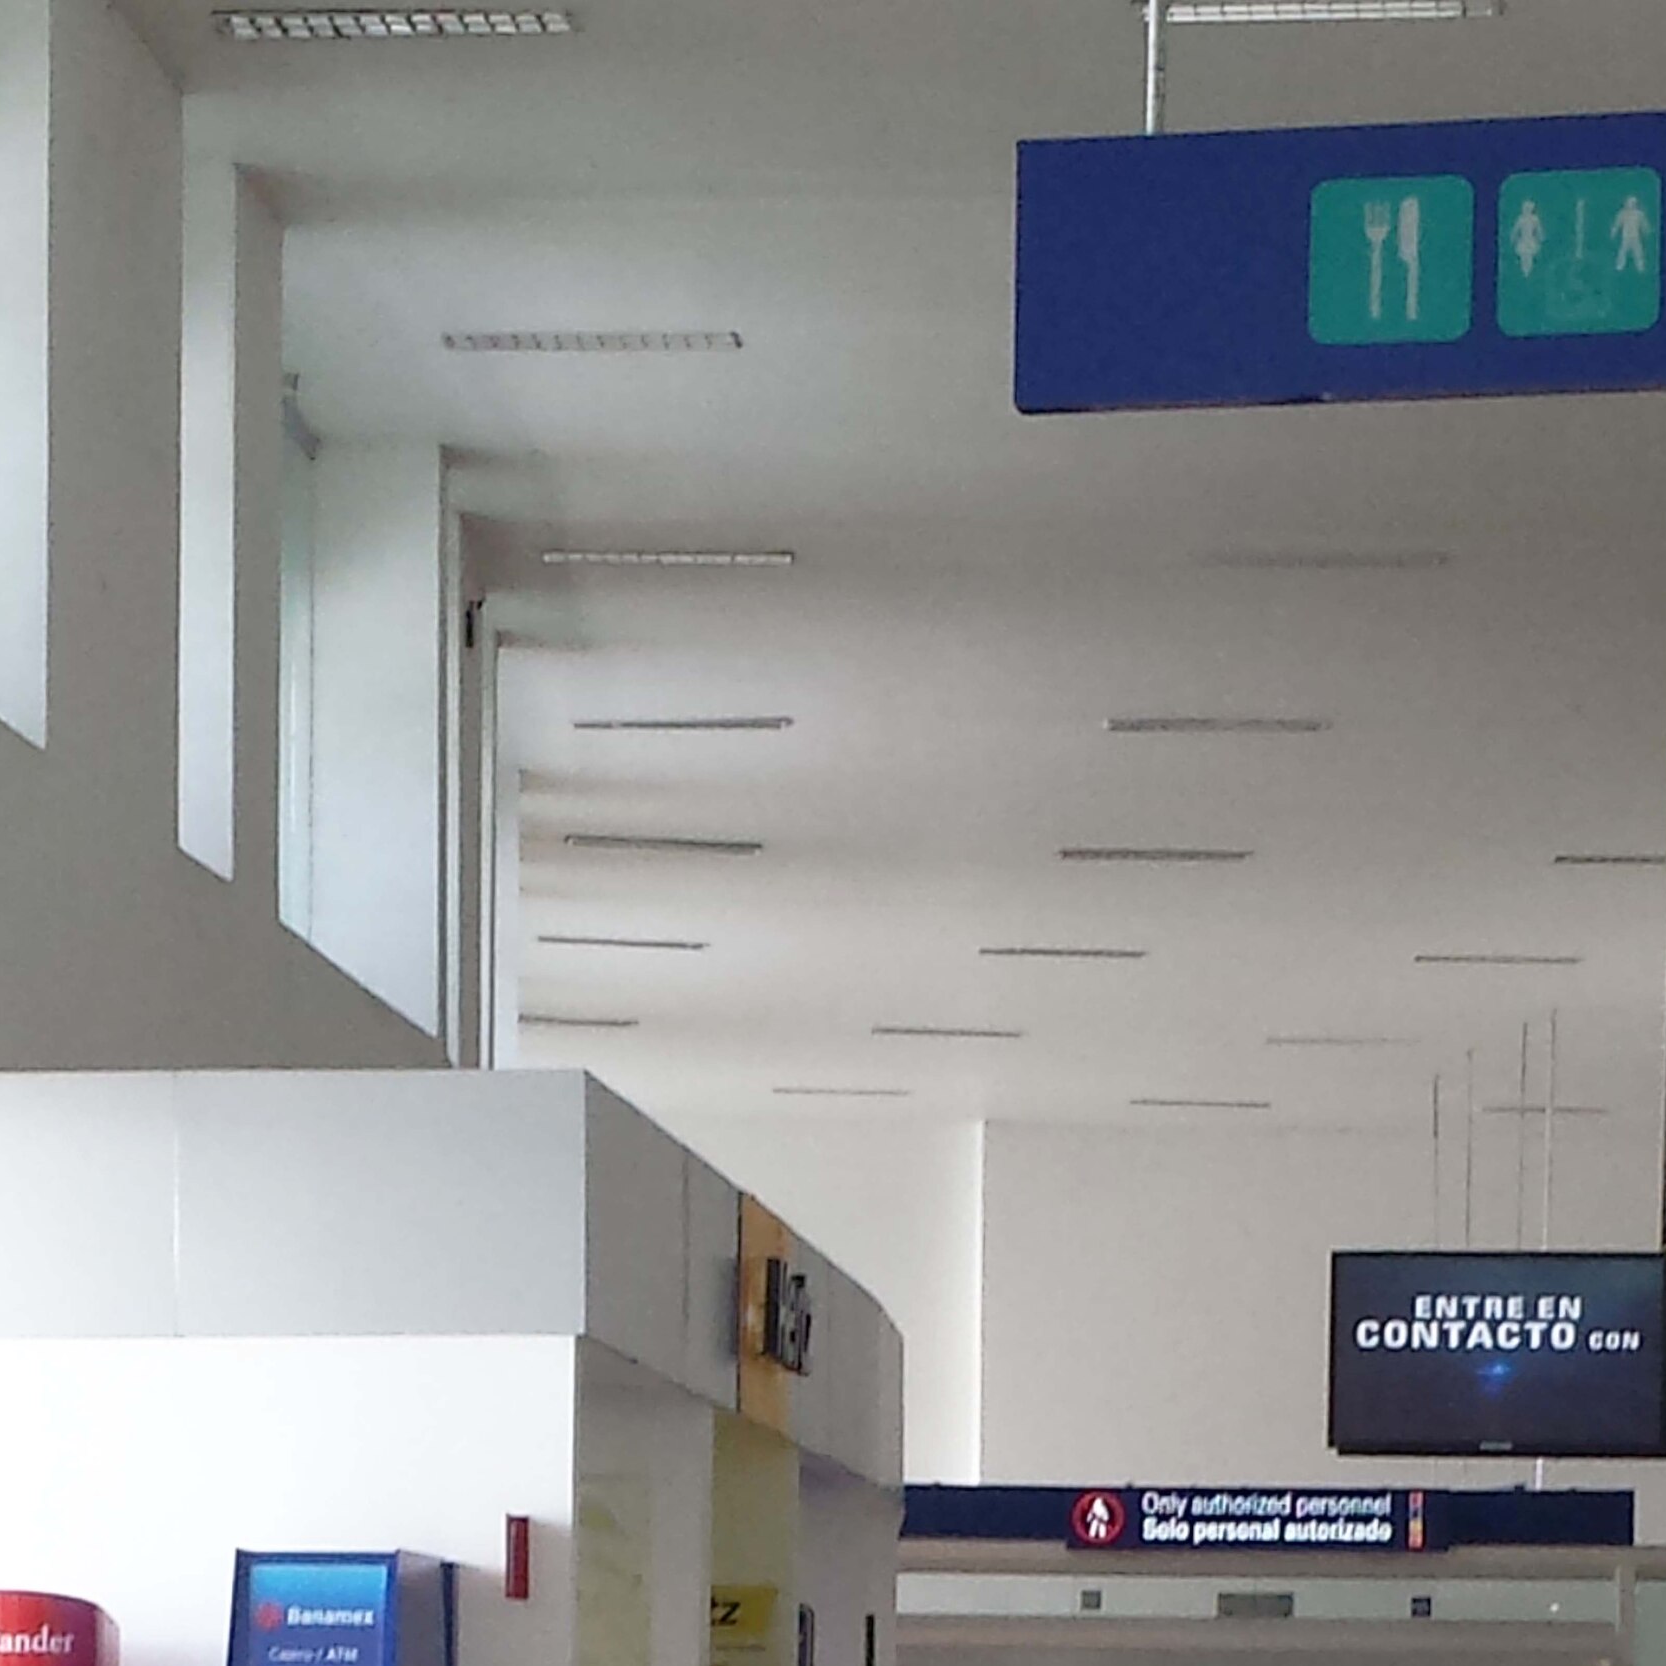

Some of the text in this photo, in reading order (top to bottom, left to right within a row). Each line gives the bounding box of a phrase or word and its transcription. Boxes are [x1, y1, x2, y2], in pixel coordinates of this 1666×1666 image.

[1414, 1295, 1582, 1320] ENTRE EN
[1355, 1319, 1640, 1351] CONTACTO CON
[1141, 1492, 1392, 1518] Only authorized personnel
[1143, 1518, 1393, 1545] Solo personal autorizado
[286, 1605, 374, 1627] Banamex
